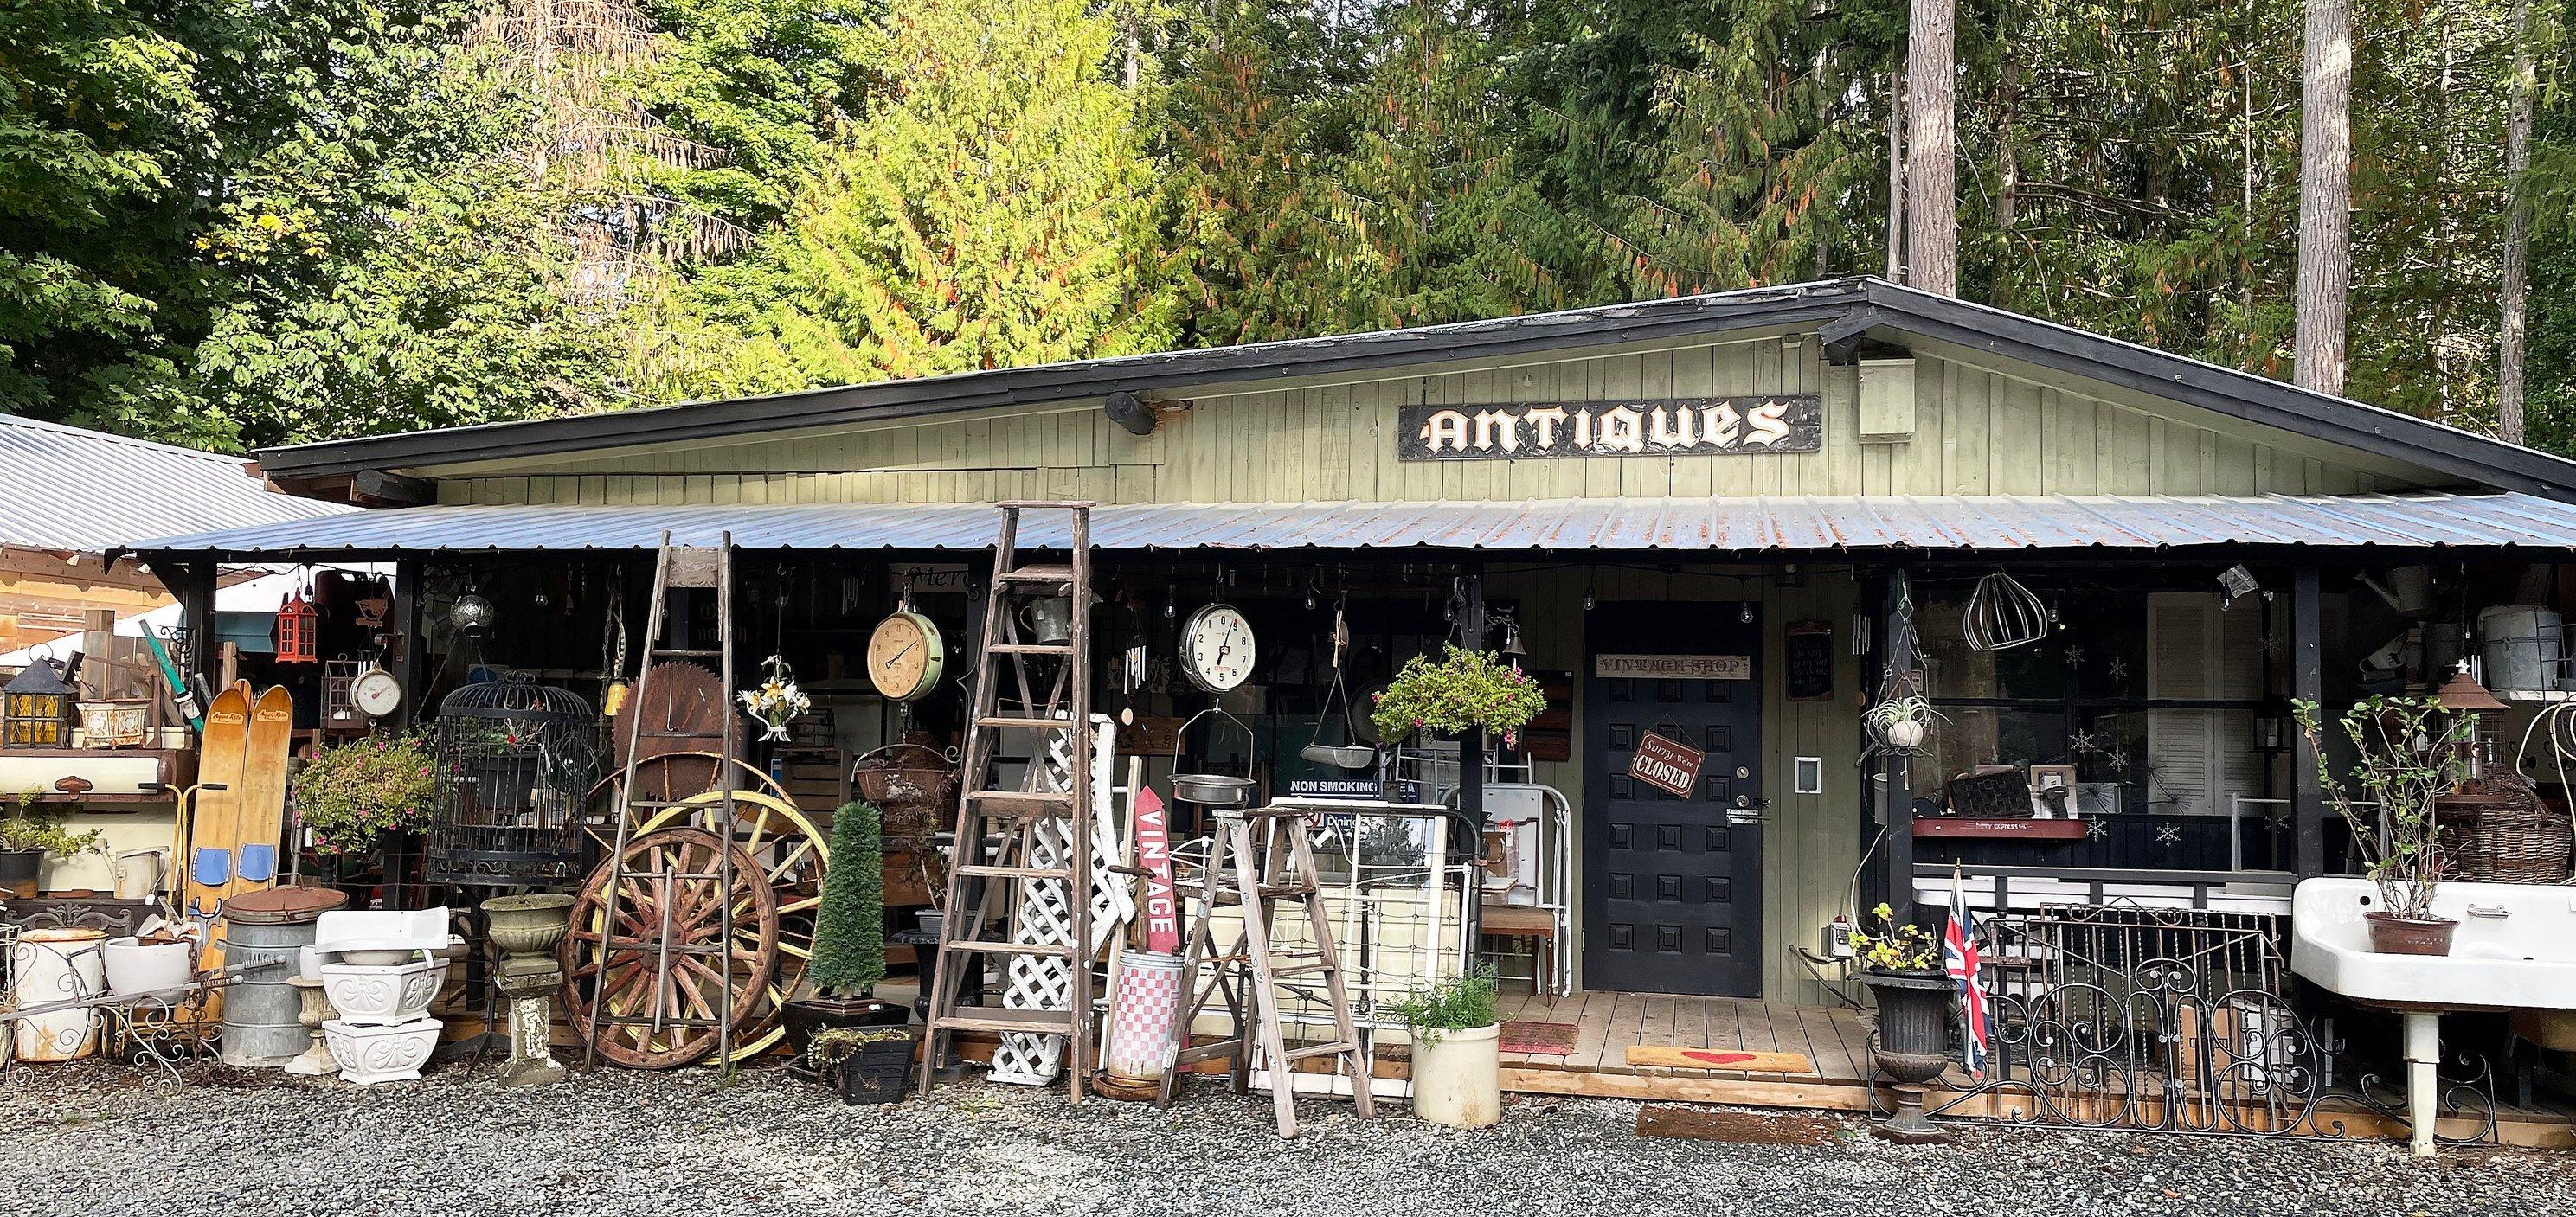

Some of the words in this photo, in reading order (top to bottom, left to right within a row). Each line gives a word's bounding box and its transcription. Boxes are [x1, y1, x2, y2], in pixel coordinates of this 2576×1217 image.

[1208, 619, 1211, 628] 1
[1221, 616, 1225, 625] 0
[1198, 634, 1204, 643] 2
[1241, 637, 1246, 645] 8
[1198, 652, 1203, 661] 3
[1231, 668, 1237, 676] 6
[1645, 740, 1675, 761] Sorry
[1677, 754, 1694, 768] We're
[1636, 754, 1690, 789] CLOSED
[1290, 780, 1317, 791] NON
[1320, 780, 1378, 792] SMOKING
[1139, 810, 1174, 933] VINTAGE
